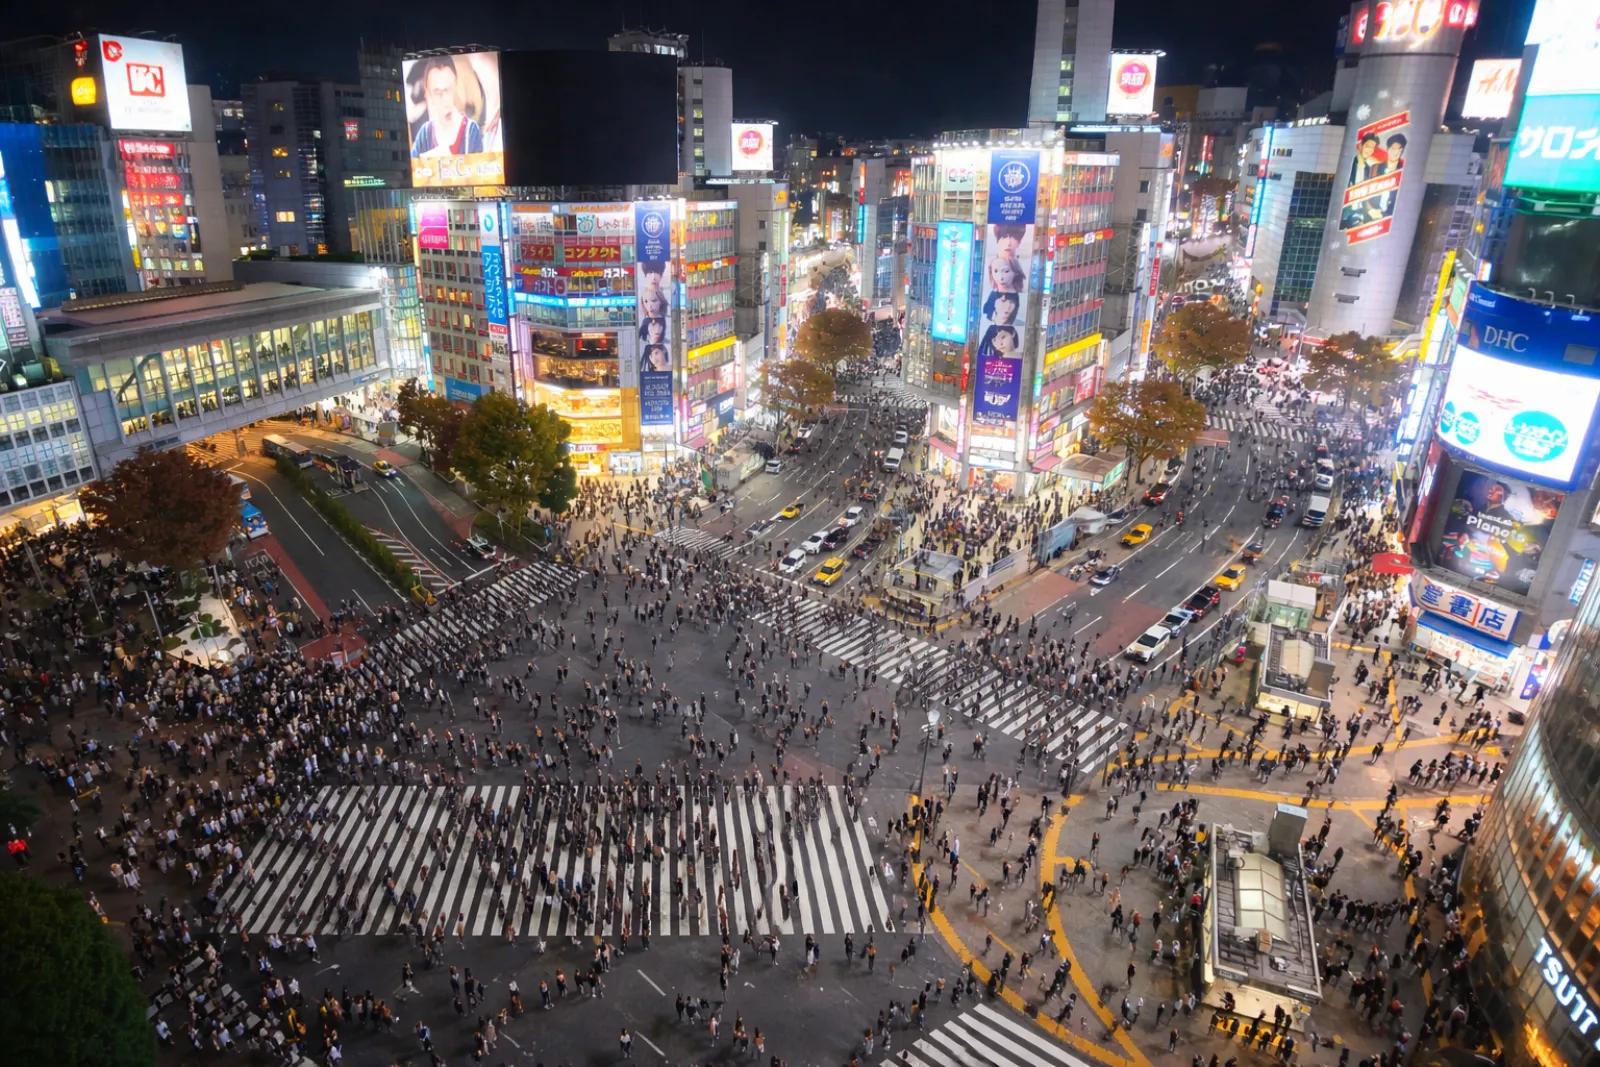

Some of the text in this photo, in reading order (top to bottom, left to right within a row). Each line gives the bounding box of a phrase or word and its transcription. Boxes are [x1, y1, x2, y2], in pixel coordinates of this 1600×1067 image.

[565, 246, 620, 260] コンタクト
[1483, 325, 1529, 352] DHC
